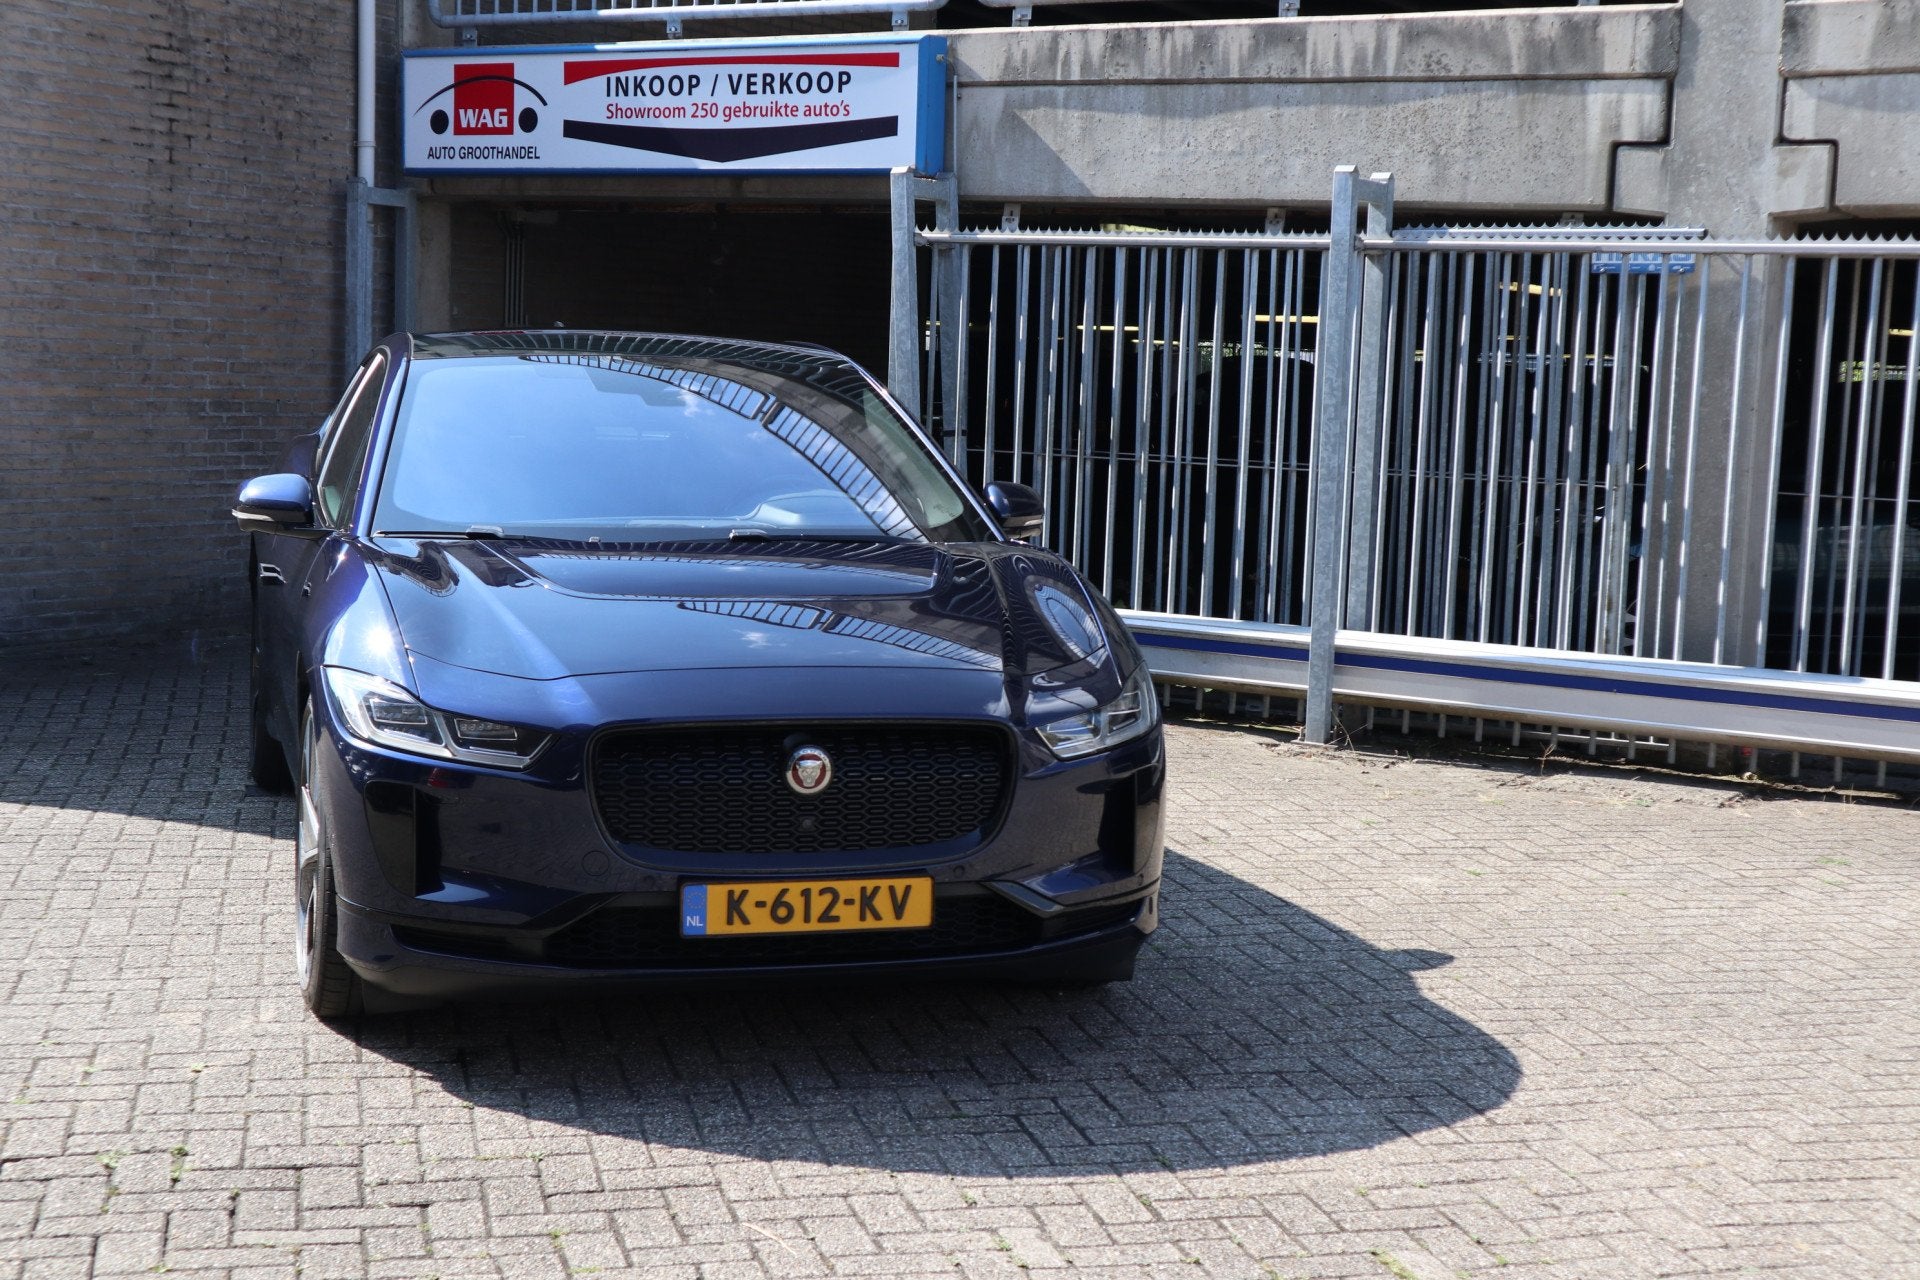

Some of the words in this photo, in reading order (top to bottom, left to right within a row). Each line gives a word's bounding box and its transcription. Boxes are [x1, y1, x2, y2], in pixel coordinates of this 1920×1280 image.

[606, 74, 701, 98] INKOOP
[727, 70, 852, 96] VERKOOP
[458, 108, 508, 128] WAG
[606, 102, 686, 120] Showroom
[690, 102, 719, 119] 250
[722, 100, 799, 123] gebruikte
[803, 99, 850, 118] auto's
[427, 146, 456, 160] AUTO
[458, 146, 540, 160] GROOTHANDEL
[725, 884, 912, 926] K-612-KV
[686, 915, 704, 928] NL
